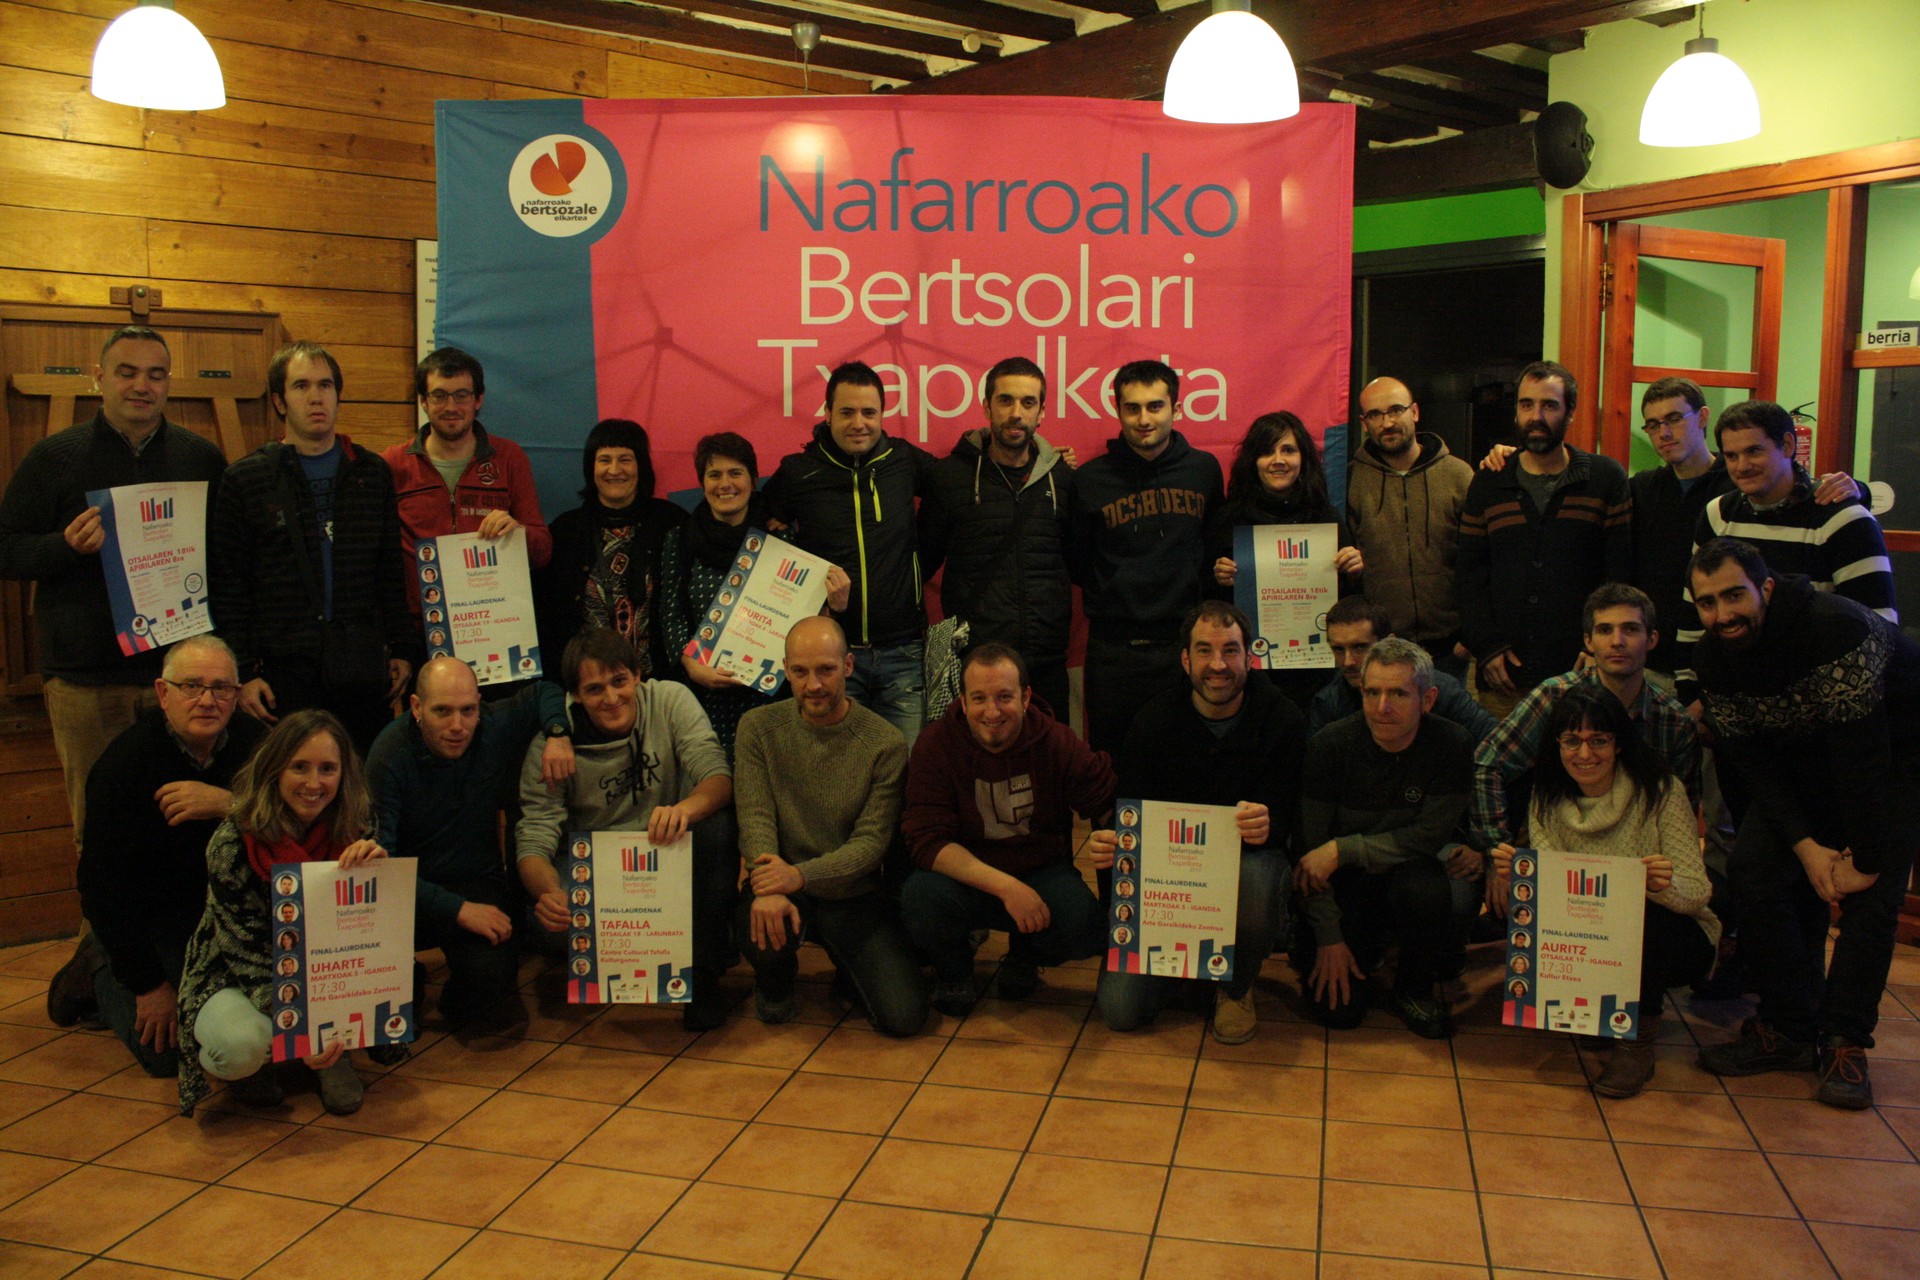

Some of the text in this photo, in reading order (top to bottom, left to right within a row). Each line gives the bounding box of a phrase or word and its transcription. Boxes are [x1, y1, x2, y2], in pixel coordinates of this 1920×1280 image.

[759, 147, 1239, 238] Nafarroako
[521, 203, 598, 215] bertsozale
[801, 243, 1195, 328] Bertsolari
[1867, 330, 1911, 345] berria
[757, 335, 1227, 442] Taplka
[128, 546, 196, 565] OTSAILAREN 18tik
[129, 558, 170, 572] APIRILAREN
[1261, 587, 1307, 595] OTSAILAREN
[451, 597, 505, 607] FINAL-LAURDENAK
[453, 610, 490, 622] AURITZ
[453, 621, 481, 629] OTSAILAK
[494, 616, 520, 624] IGANDEA
[455, 628, 482, 639] 17:30
[1144, 877, 1208, 888] FINAL-LAURDENAK
[1144, 890, 1192, 903] UHARTE
[1143, 901, 1180, 910] MARTXOAK
[1144, 909, 1174, 920] 17:30
[601, 920, 651, 929] TAFALLA
[1157, 921, 1197, 929] Garaikideko
[1542, 929, 1609, 941] FINAL-LAURDENAK
[311, 942, 380, 956] FINAL-LAURDENAK
[602, 938, 631, 949] 17:30
[1541, 942, 1587, 955] AURITZ
[311, 957, 365, 973] UHARTE
[1541, 953, 1574, 962] OTSAILAK
[1590, 959, 1622, 967] IGANDEA
[311, 971, 352, 982] MARTXOAK
[364, 966, 397, 975] IGANDEA
[1541, 962, 1573, 974] 17:30
[312, 981, 346, 994] 17:30
[328, 990, 371, 1000] Garaikideko
[373, 986, 401, 994] Zentroa
